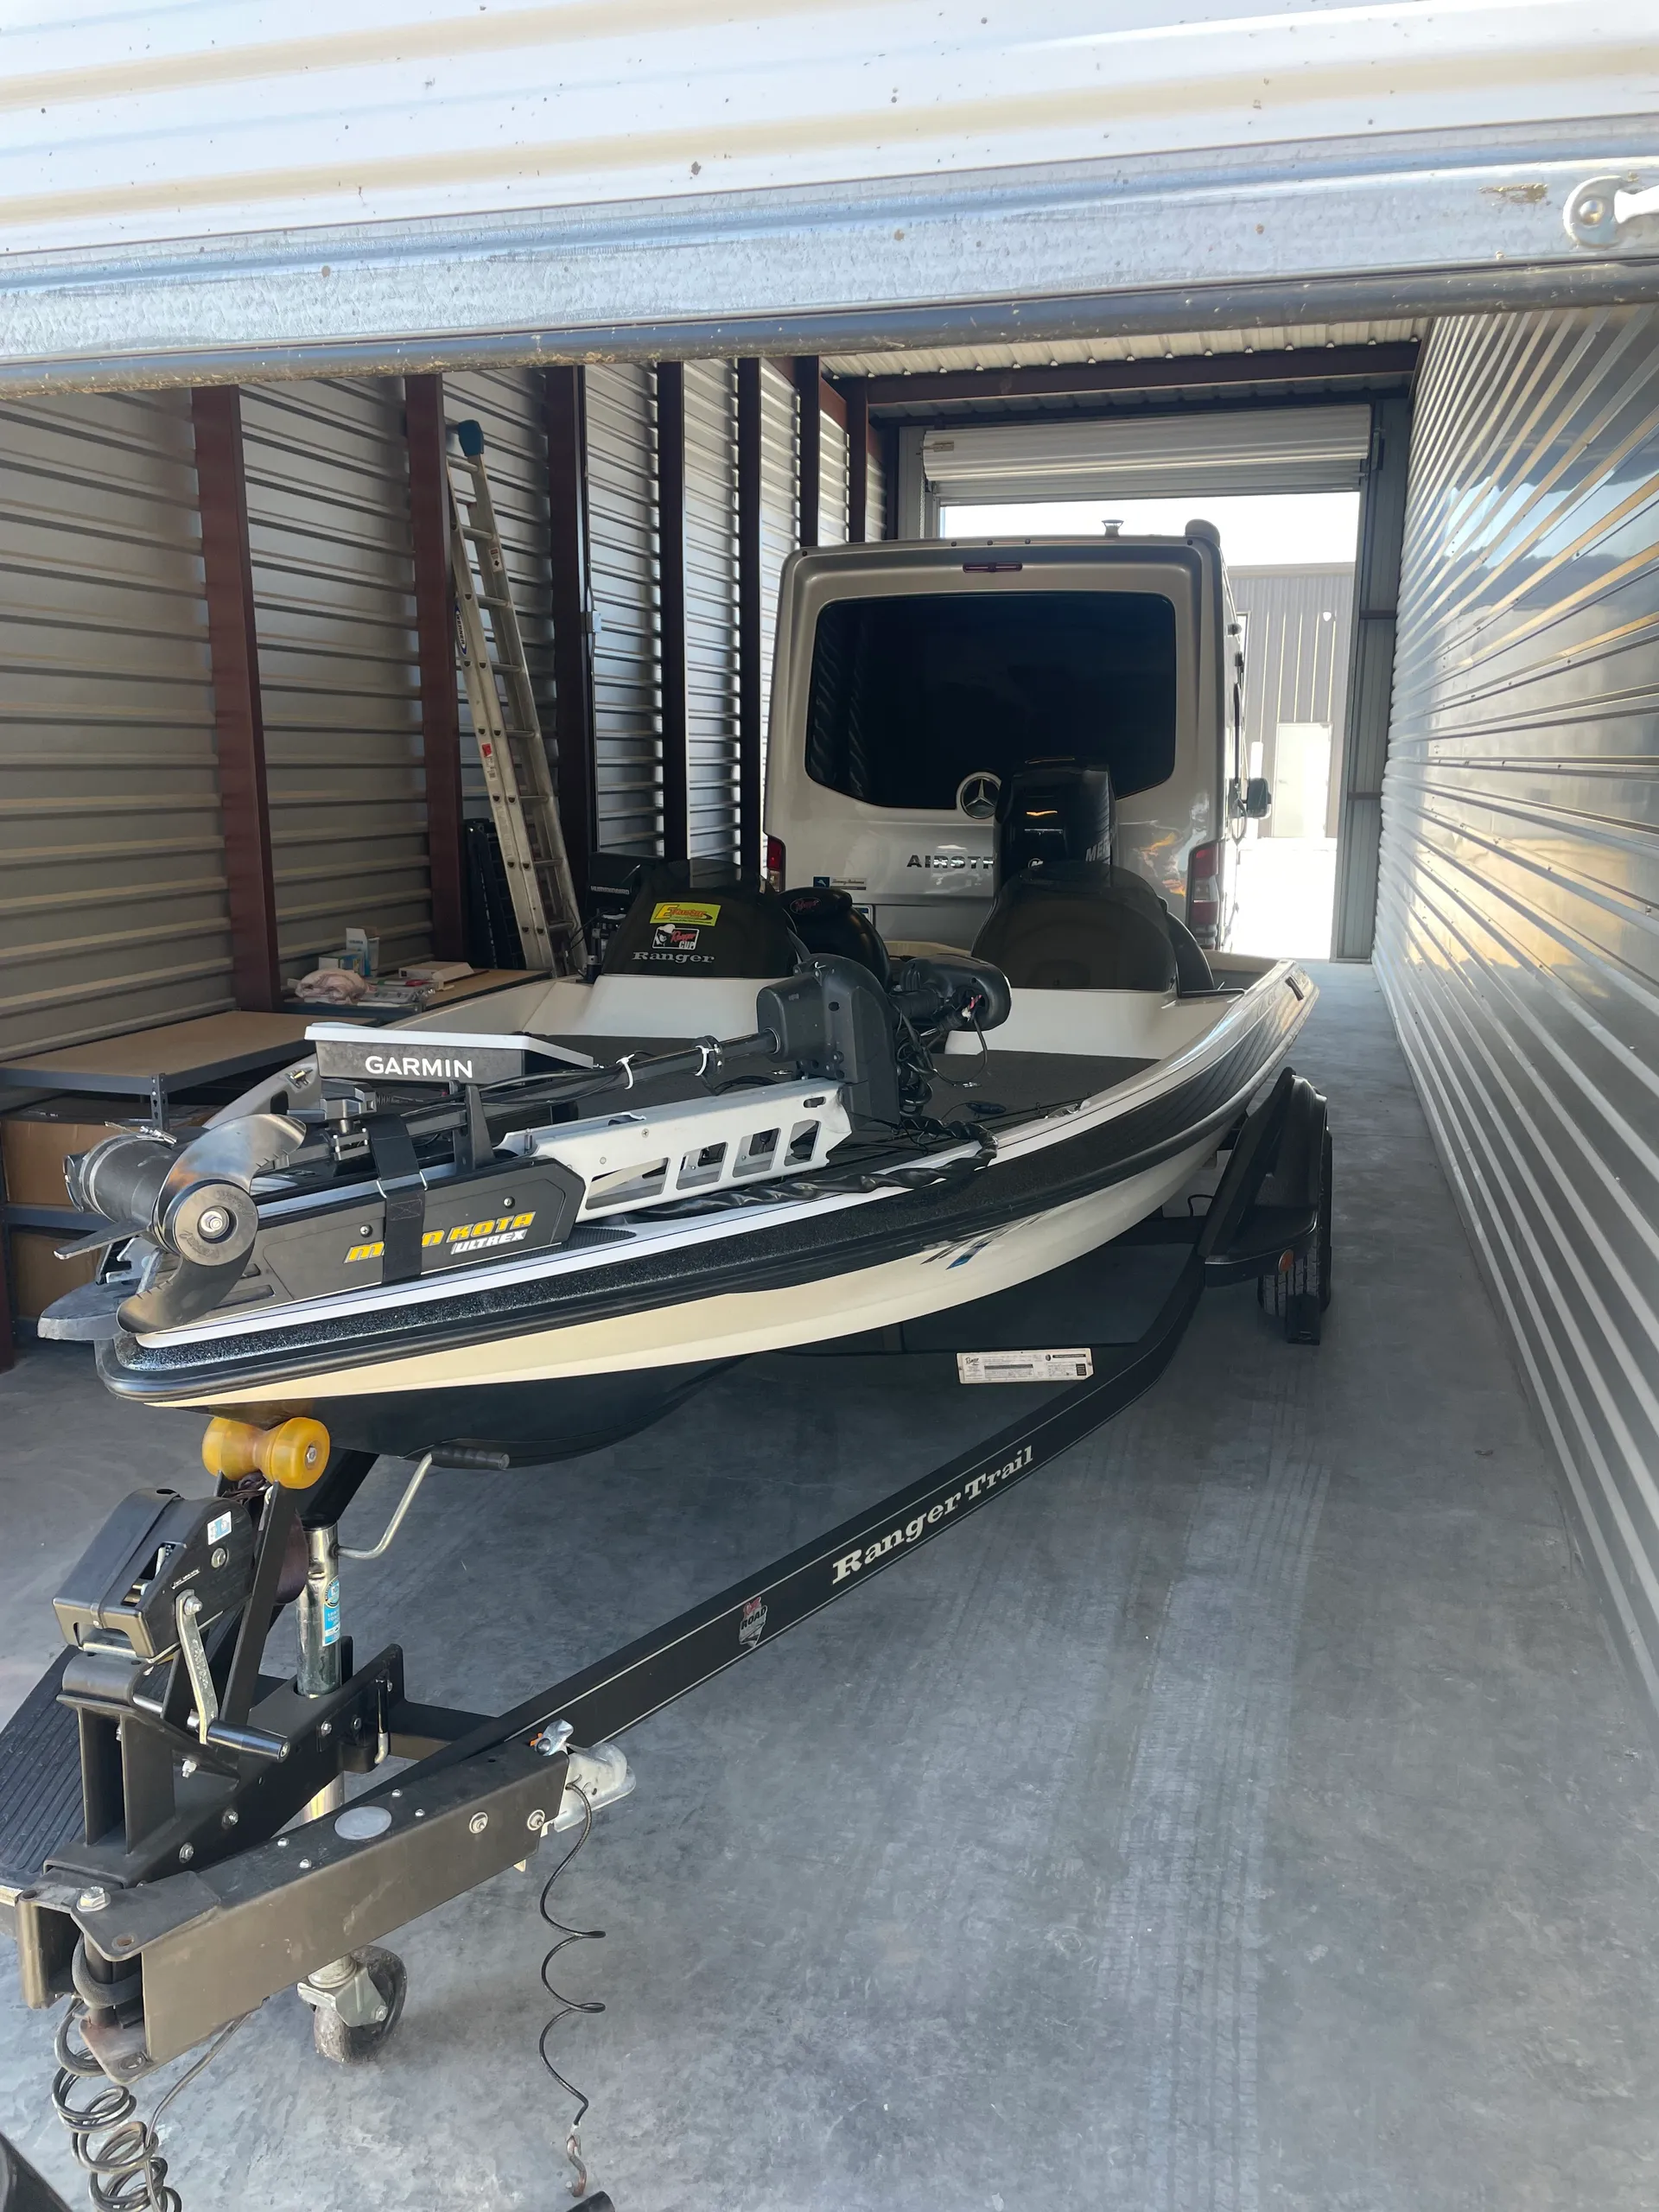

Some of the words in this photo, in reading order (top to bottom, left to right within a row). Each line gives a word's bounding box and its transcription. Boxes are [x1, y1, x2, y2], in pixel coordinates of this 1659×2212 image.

[632, 951, 715, 963] Ranger
[365, 1055, 474, 1078] GARMIN
[446, 1211, 537, 1243] KOTA
[450, 1228, 528, 1255] ULTREX
[741, 1606, 766, 1630] ROAD
